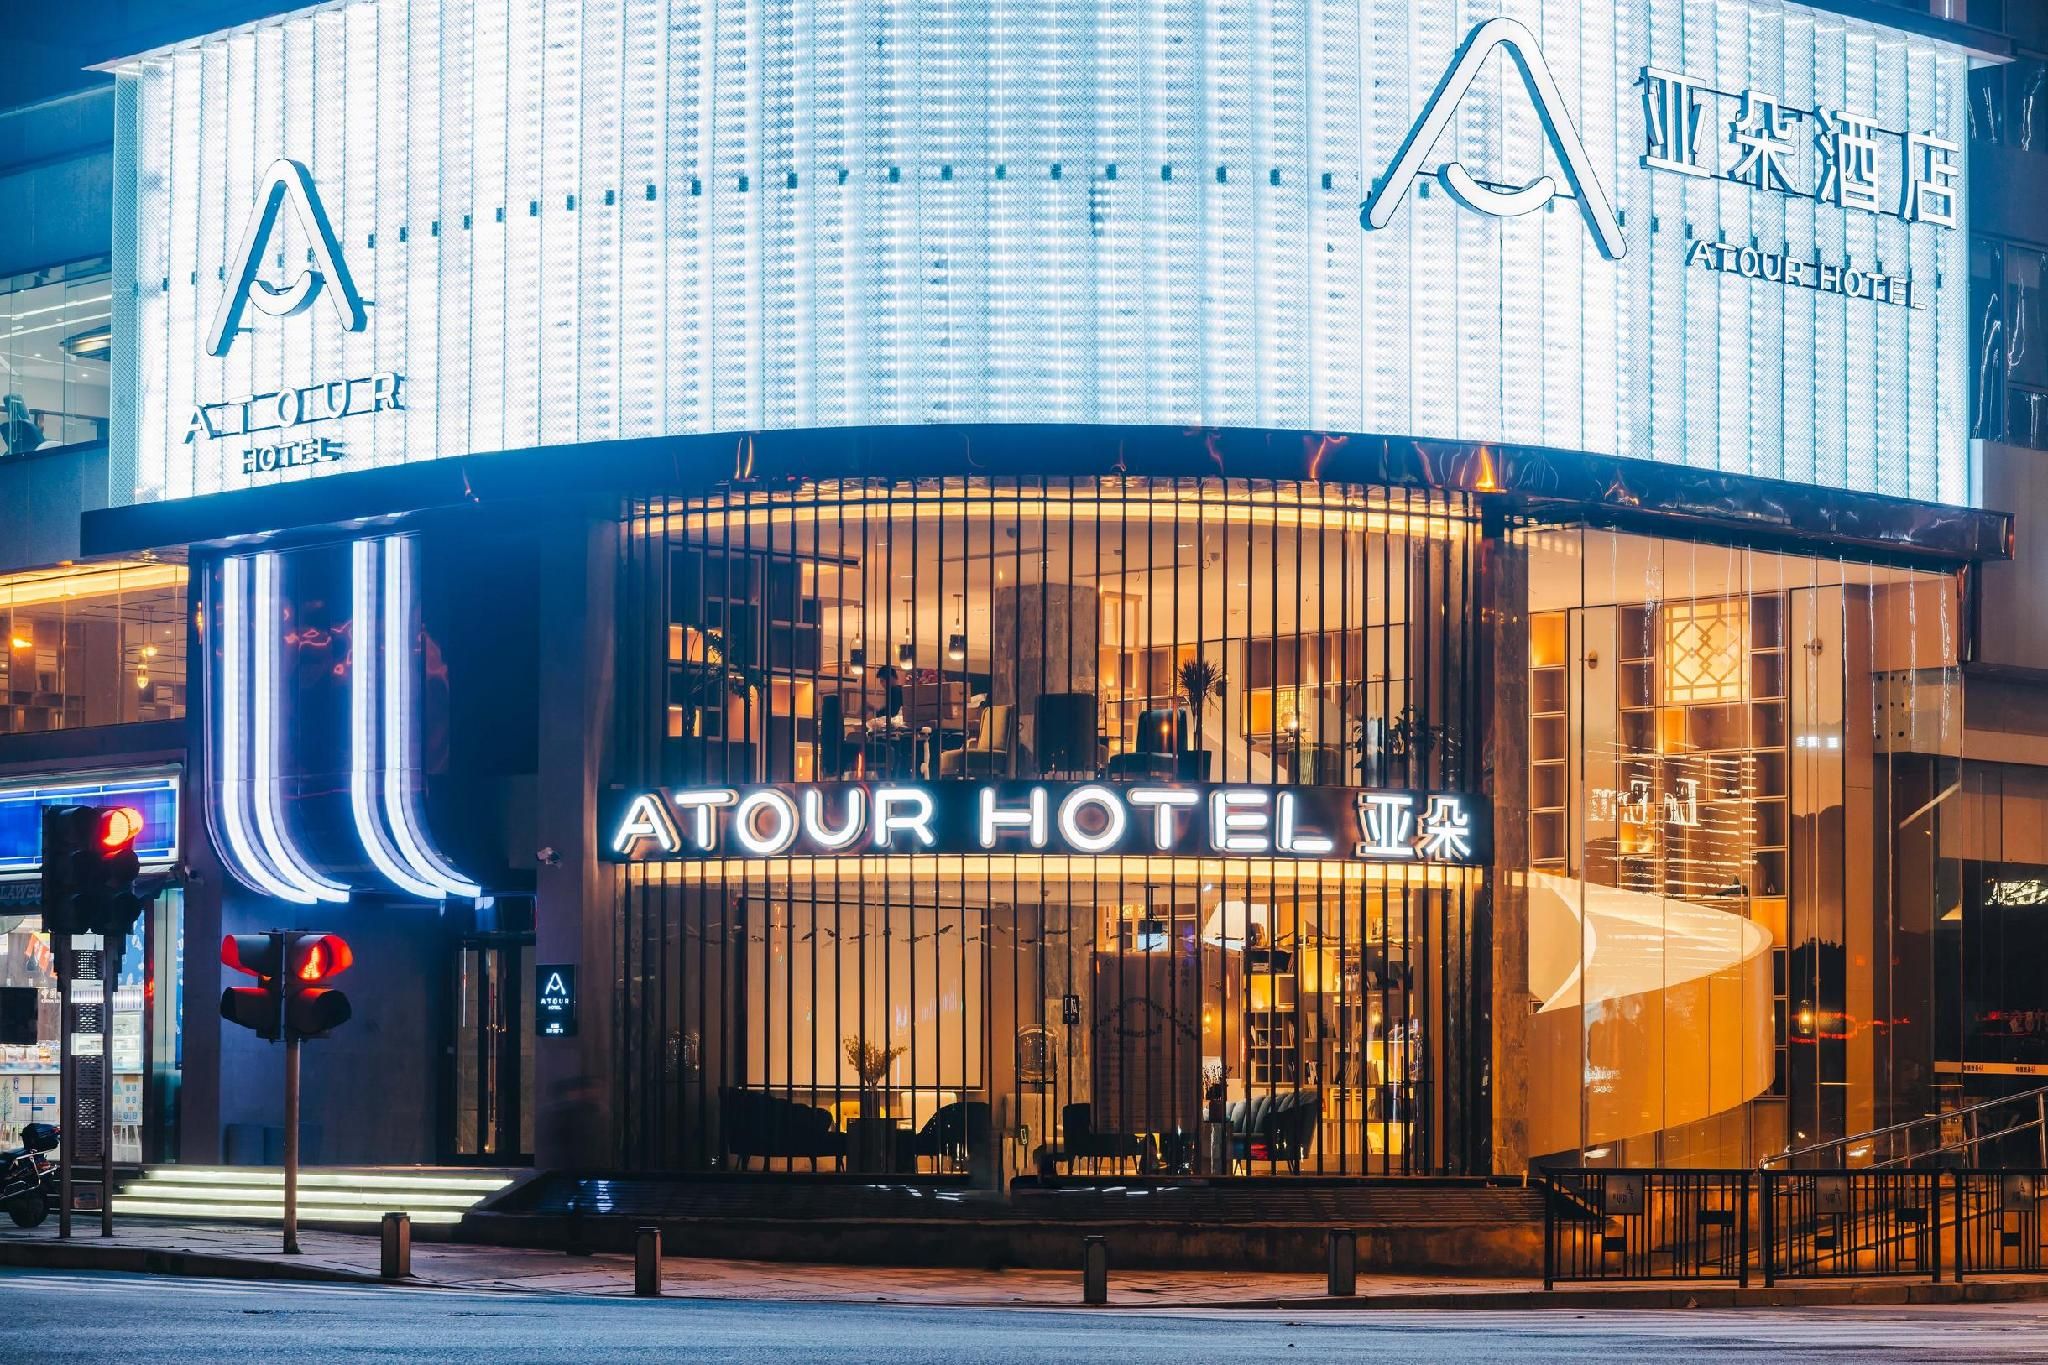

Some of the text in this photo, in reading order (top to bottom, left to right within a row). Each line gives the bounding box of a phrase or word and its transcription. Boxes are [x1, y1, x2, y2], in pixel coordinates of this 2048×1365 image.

[1639, 65, 1960, 229] 亚朵酒店
[1685, 239, 1927, 311] ATOUR HOTEL
[183, 371, 406, 444] ATOUR
[242, 437, 342, 475] HOTEL
[613, 785, 1333, 855] ATOUR HOTEL
[1356, 791, 1472, 860] 亚朵
[541, 997, 569, 1005] ATOUR
